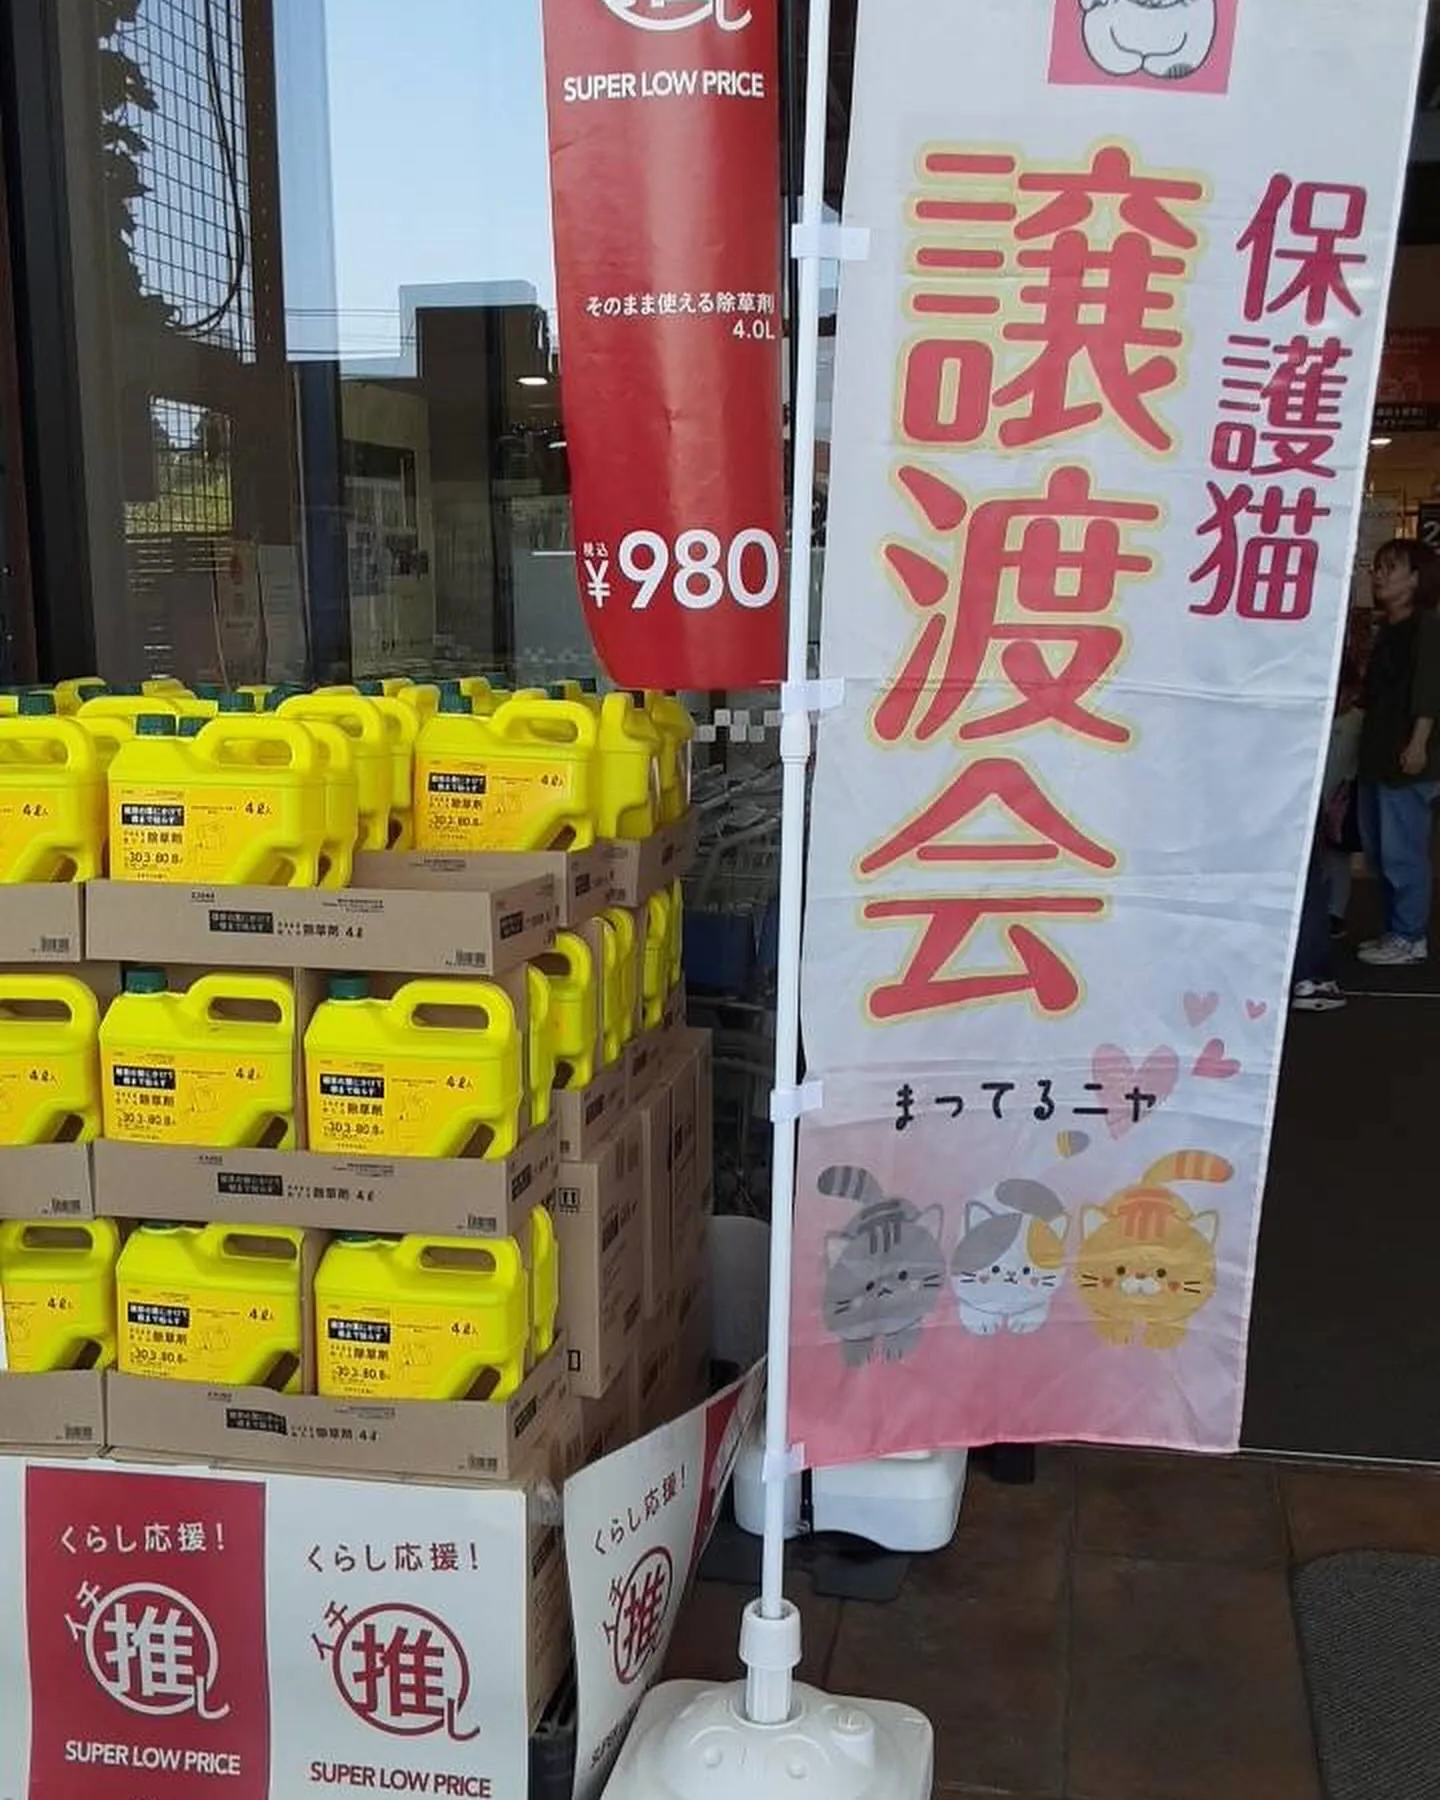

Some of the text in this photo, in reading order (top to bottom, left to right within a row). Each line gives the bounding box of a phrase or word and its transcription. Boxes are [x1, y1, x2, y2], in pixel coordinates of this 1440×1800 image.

[564, 70, 765, 102] SUPER LOW PRICE
[586, 292, 775, 317] そのまま使える除草剤
[733, 319, 775, 340] 4.0L
[1189, 173, 1368, 621] 保護猫
[858, 142, 1206, 1022] 譲渡会
[895, 1079, 1157, 1131] まってるニャ
[595, 1463, 688, 1555] くらし応援!
[60, 1521, 225, 1554] くらし応援!
[307, 1542, 479, 1572] くらし応援!
[65, 1739, 241, 1776] SUPER LOW PRICE
[310, 1761, 492, 1799] SUPER LOW PRICE
